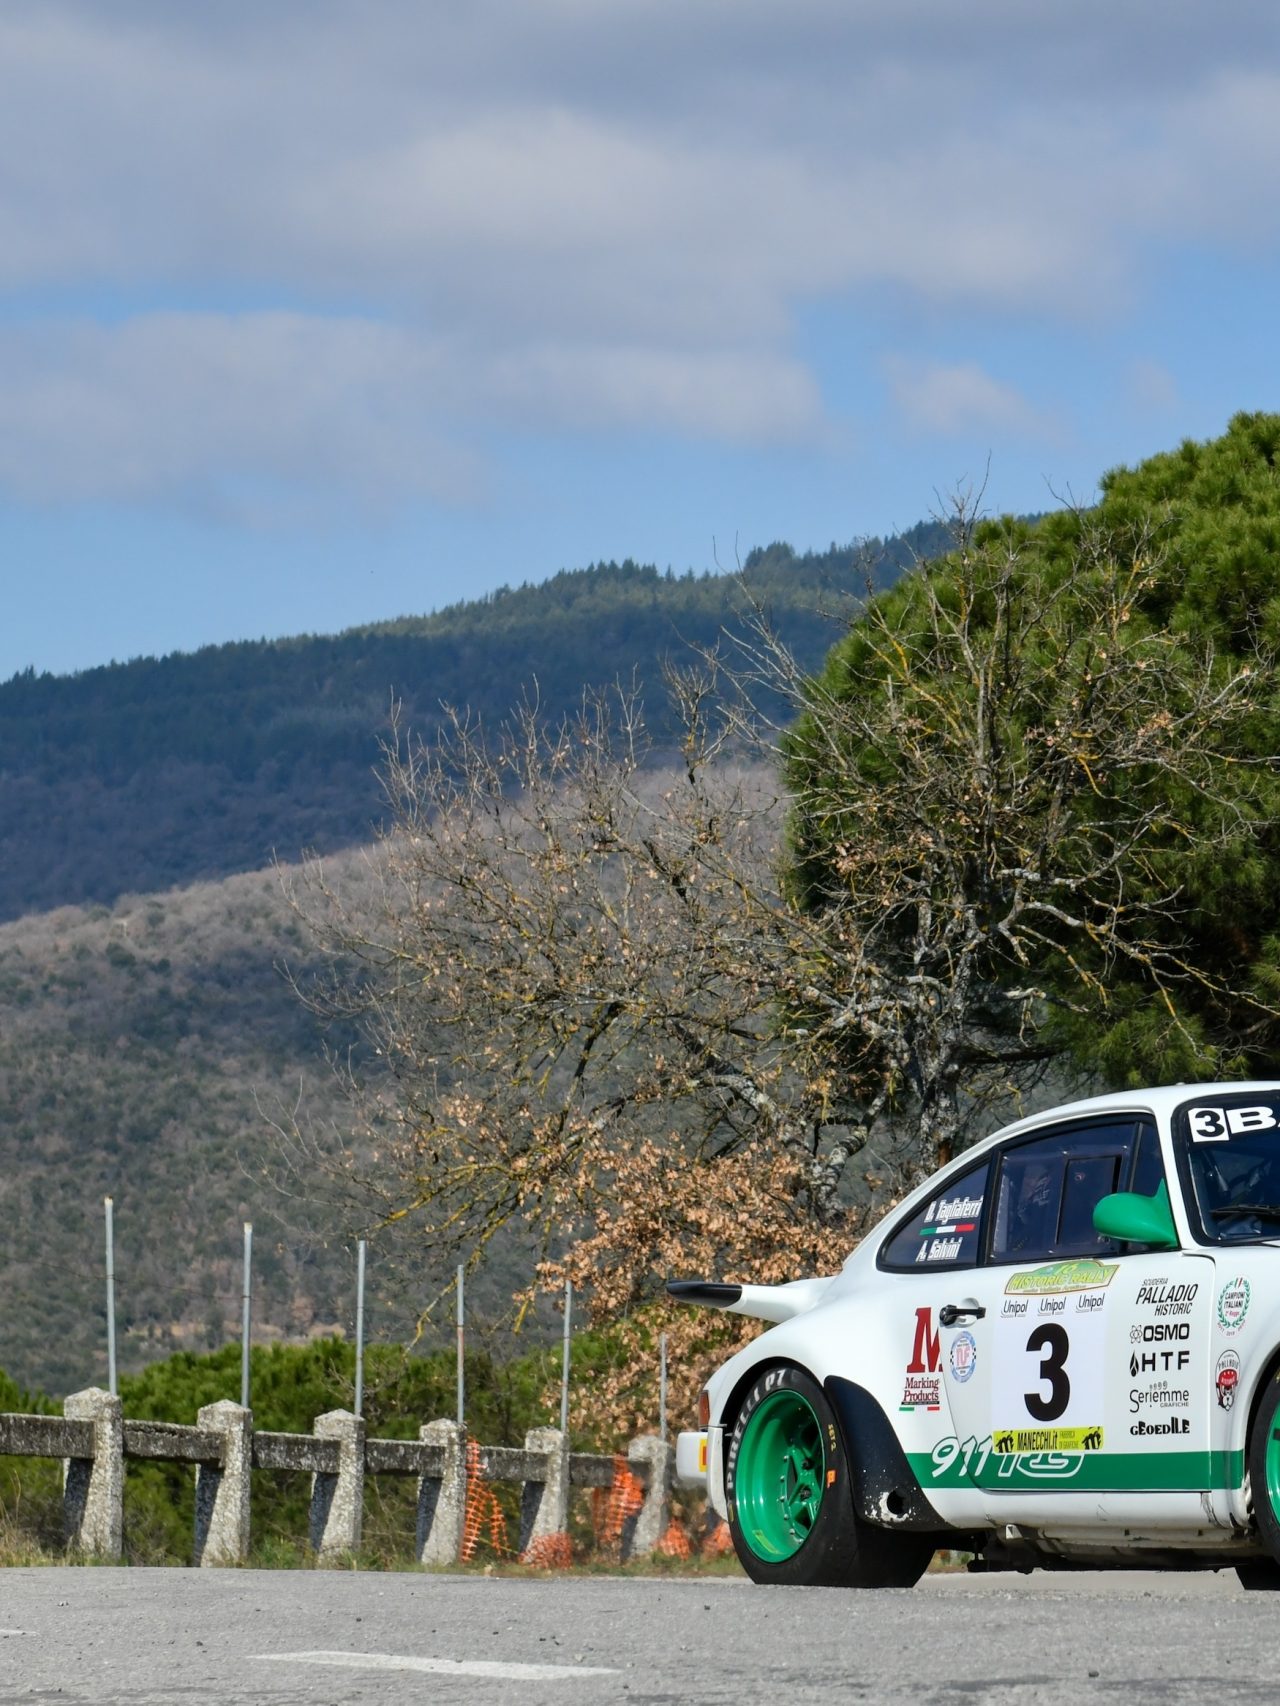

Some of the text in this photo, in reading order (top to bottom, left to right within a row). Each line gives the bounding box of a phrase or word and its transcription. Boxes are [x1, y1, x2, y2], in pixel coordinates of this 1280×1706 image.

[1195, 1110, 1225, 1137] 3
[916, 1237, 963, 1262] A. Salvini
[1078, 1293, 1106, 1312] Unipol
[1136, 1284, 1198, 1304] PALLADIO
[1003, 1300, 1029, 1318] Unipol
[1040, 1297, 1066, 1315] Unipol
[1155, 1303, 1192, 1316] HISTORIC
[1143, 1323, 1190, 1342] OSMO
[1142, 1351, 1190, 1372] HTF
[1024, 1323, 1070, 1421] 3
[905, 1377, 940, 1391] Marking
[903, 1390, 939, 1402] Products
[1130, 1389, 1190, 1413] Seriemme
[726, 1387, 759, 1490] PIRELLI
